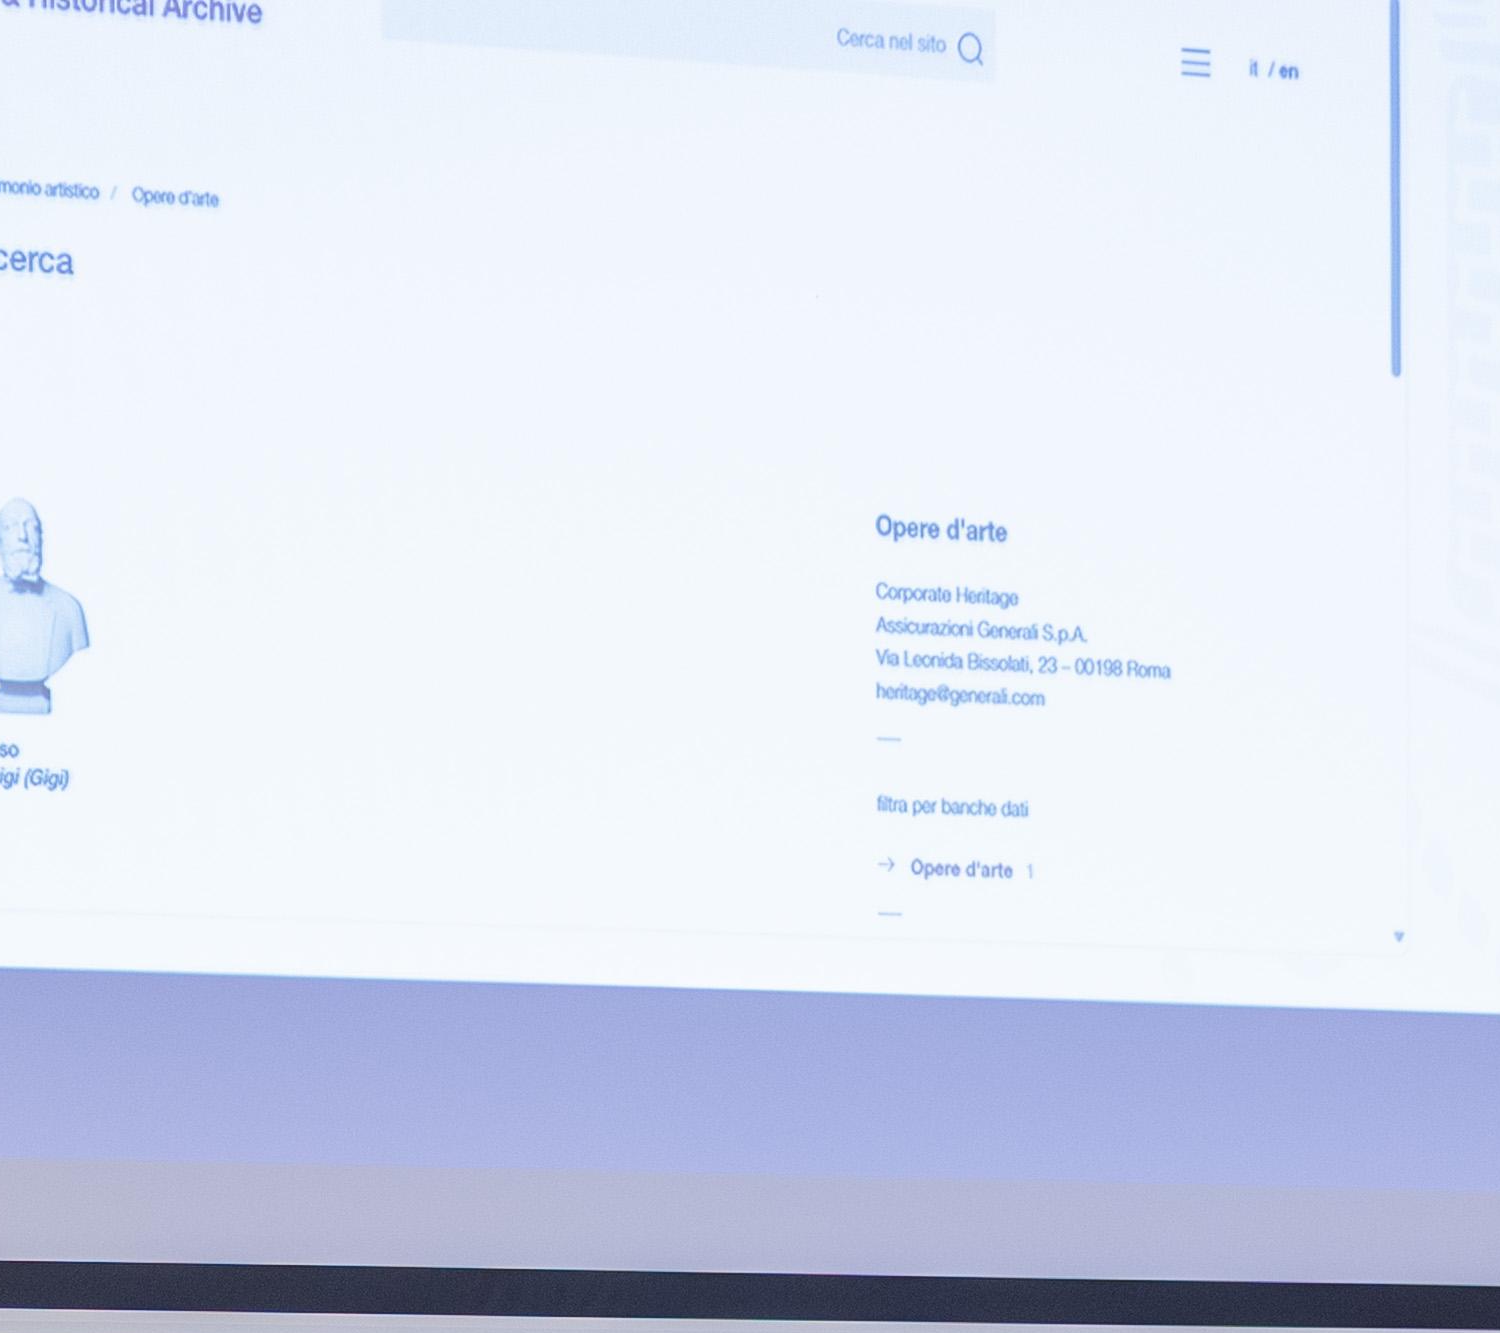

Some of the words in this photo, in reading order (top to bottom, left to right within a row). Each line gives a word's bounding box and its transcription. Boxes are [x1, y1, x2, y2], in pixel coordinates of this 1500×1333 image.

[162, 0, 263, 24] Archive
[836, 27, 884, 49] Cerca
[889, 32, 912, 51] nel
[917, 33, 947, 53] sito
[44, 180, 99, 200] artistico
[131, 186, 175, 208] Opere
[178, 188, 219, 208] d'arte
[875, 514, 940, 544] Opere
[946, 518, 1008, 544] d'arte
[875, 582, 952, 605] Corporate
[955, 586, 1019, 609] Heritage
[875, 617, 973, 639] Assicurazioni
[977, 620, 1038, 642] Generali
[1042, 625, 1088, 644] S.p.A.
[876, 650, 900, 669] Via
[903, 651, 963, 671] Leonida
[968, 653, 1033, 676] Bissolati,
[1037, 656, 1058, 675] 23
[1074, 659, 1123, 678] 00198
[1127, 660, 1172, 679] Roma
[876, 684, 1046, 707] heritage@generali.com
[23, 768, 70, 791] (Gigi)
[876, 794, 908, 814] filtra
[912, 799, 936, 818] per
[941, 798, 997, 818] banche
[1001, 799, 1029, 819] dati
[910, 858, 961, 881] Opere
[966, 860, 1013, 881] d'arte
